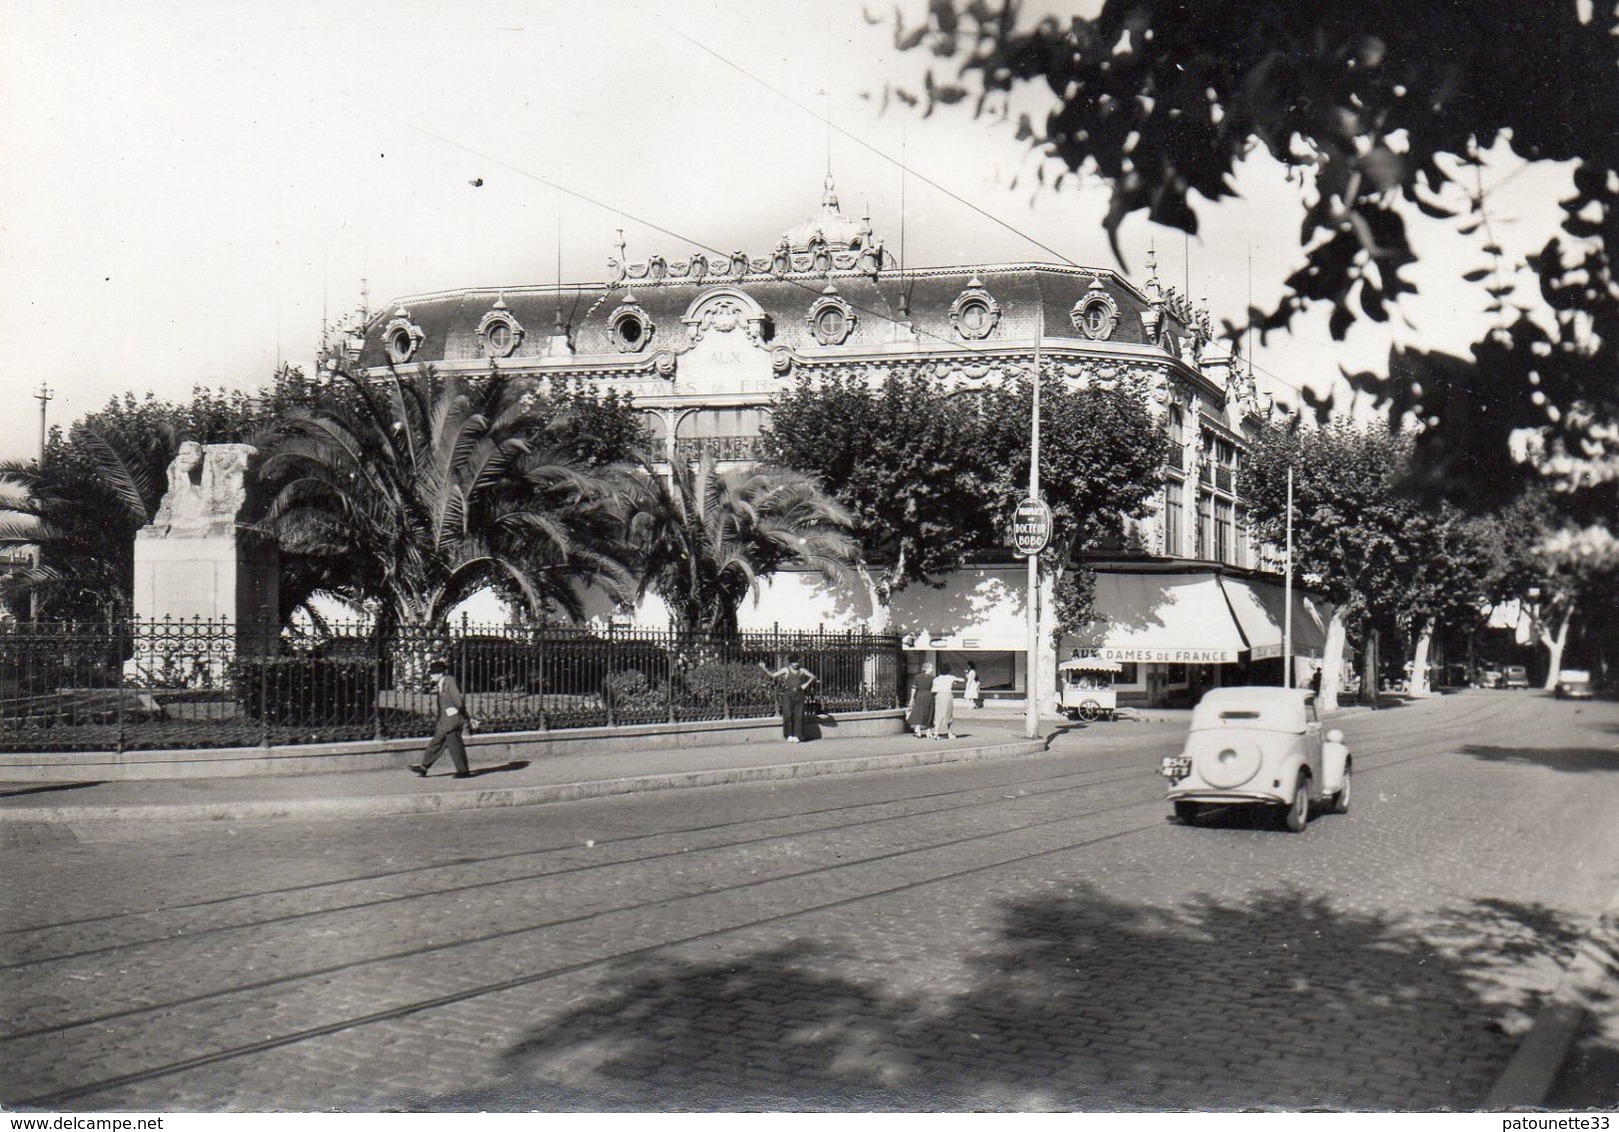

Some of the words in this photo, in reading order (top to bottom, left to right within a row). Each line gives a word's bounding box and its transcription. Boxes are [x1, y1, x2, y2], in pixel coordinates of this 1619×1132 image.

[1018, 535, 1043, 546] BOBO
[1106, 650, 1152, 661] DAMES
[1157, 652, 1170, 661] DE
[1176, 651, 1227, 661] FRANCE
